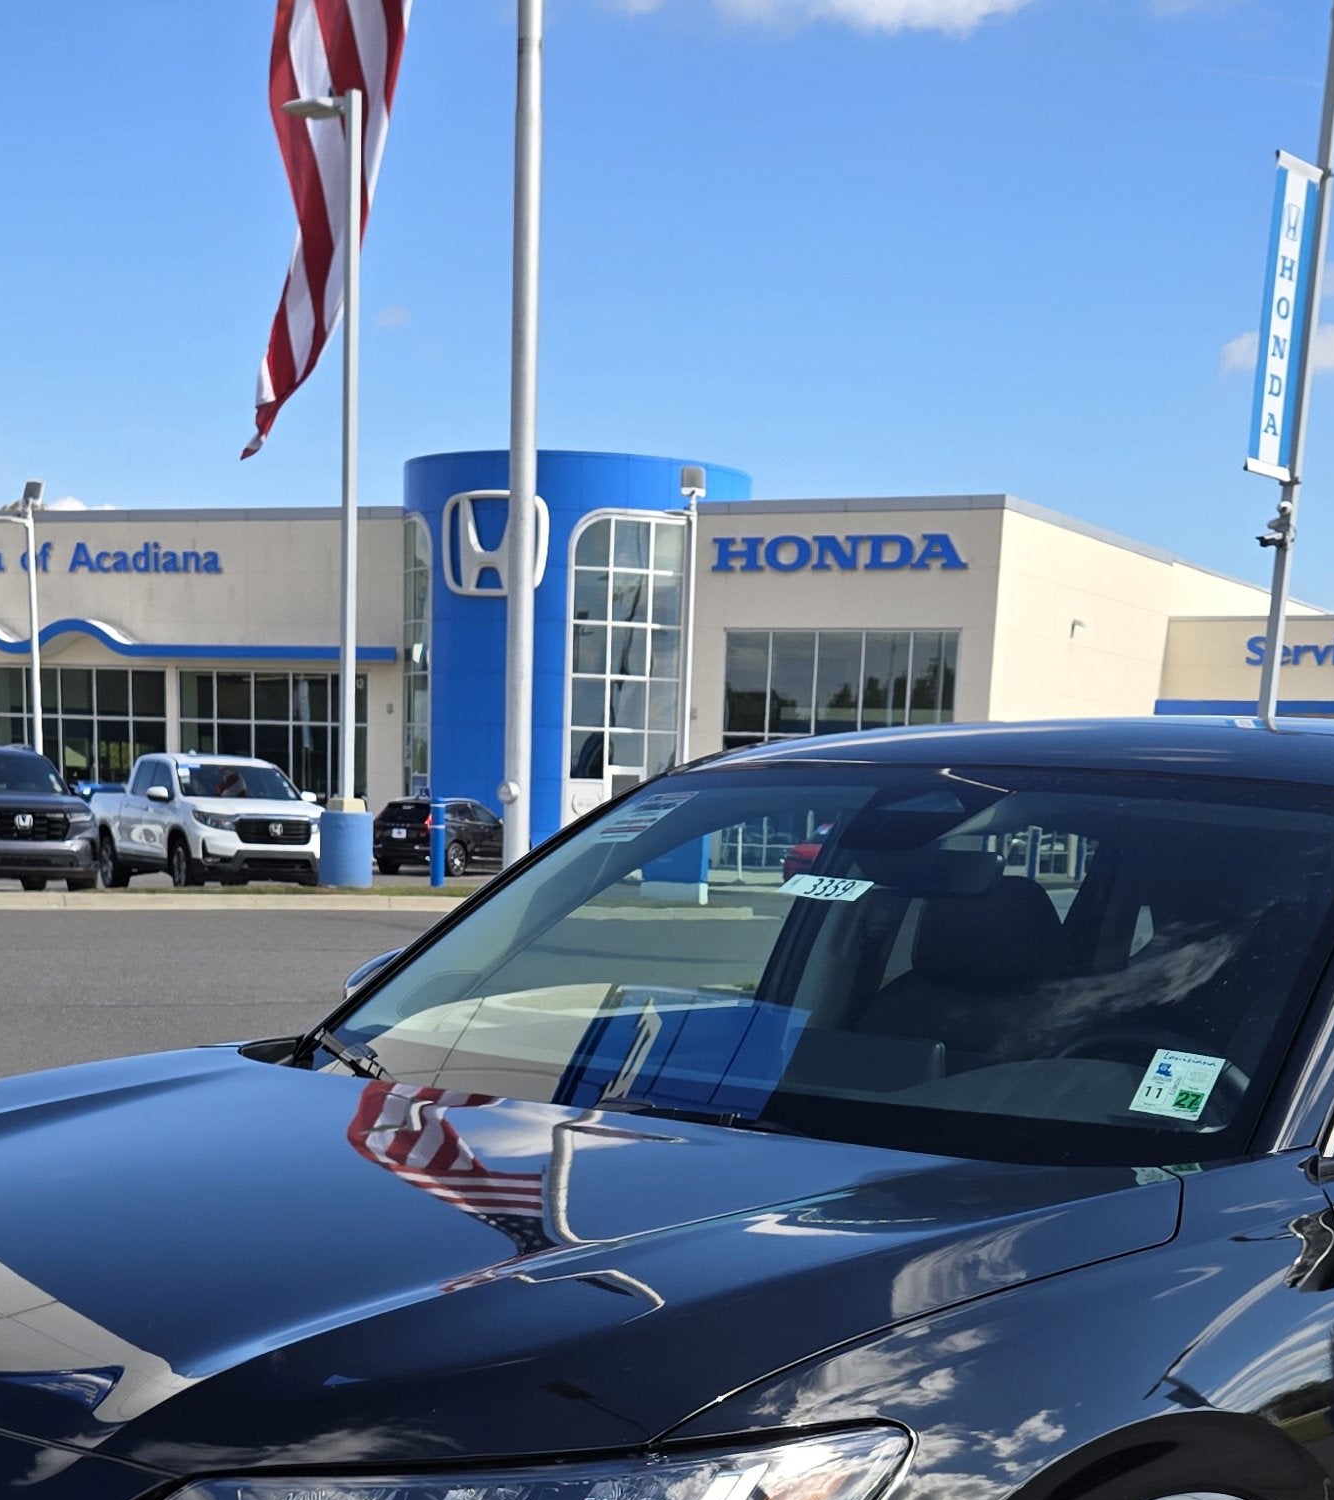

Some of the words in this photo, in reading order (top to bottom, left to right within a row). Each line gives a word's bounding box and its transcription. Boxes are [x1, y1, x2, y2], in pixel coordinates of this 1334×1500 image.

[1264, 255, 1296, 436] HONDA
[20, 541, 53, 573] of
[68, 541, 223, 574] Acadiana
[711, 533, 969, 573] HONDA
[803, 877, 857, 898] 3359
[1144, 1085, 1164, 1099] 11
[1172, 1091, 1202, 1110] 27
